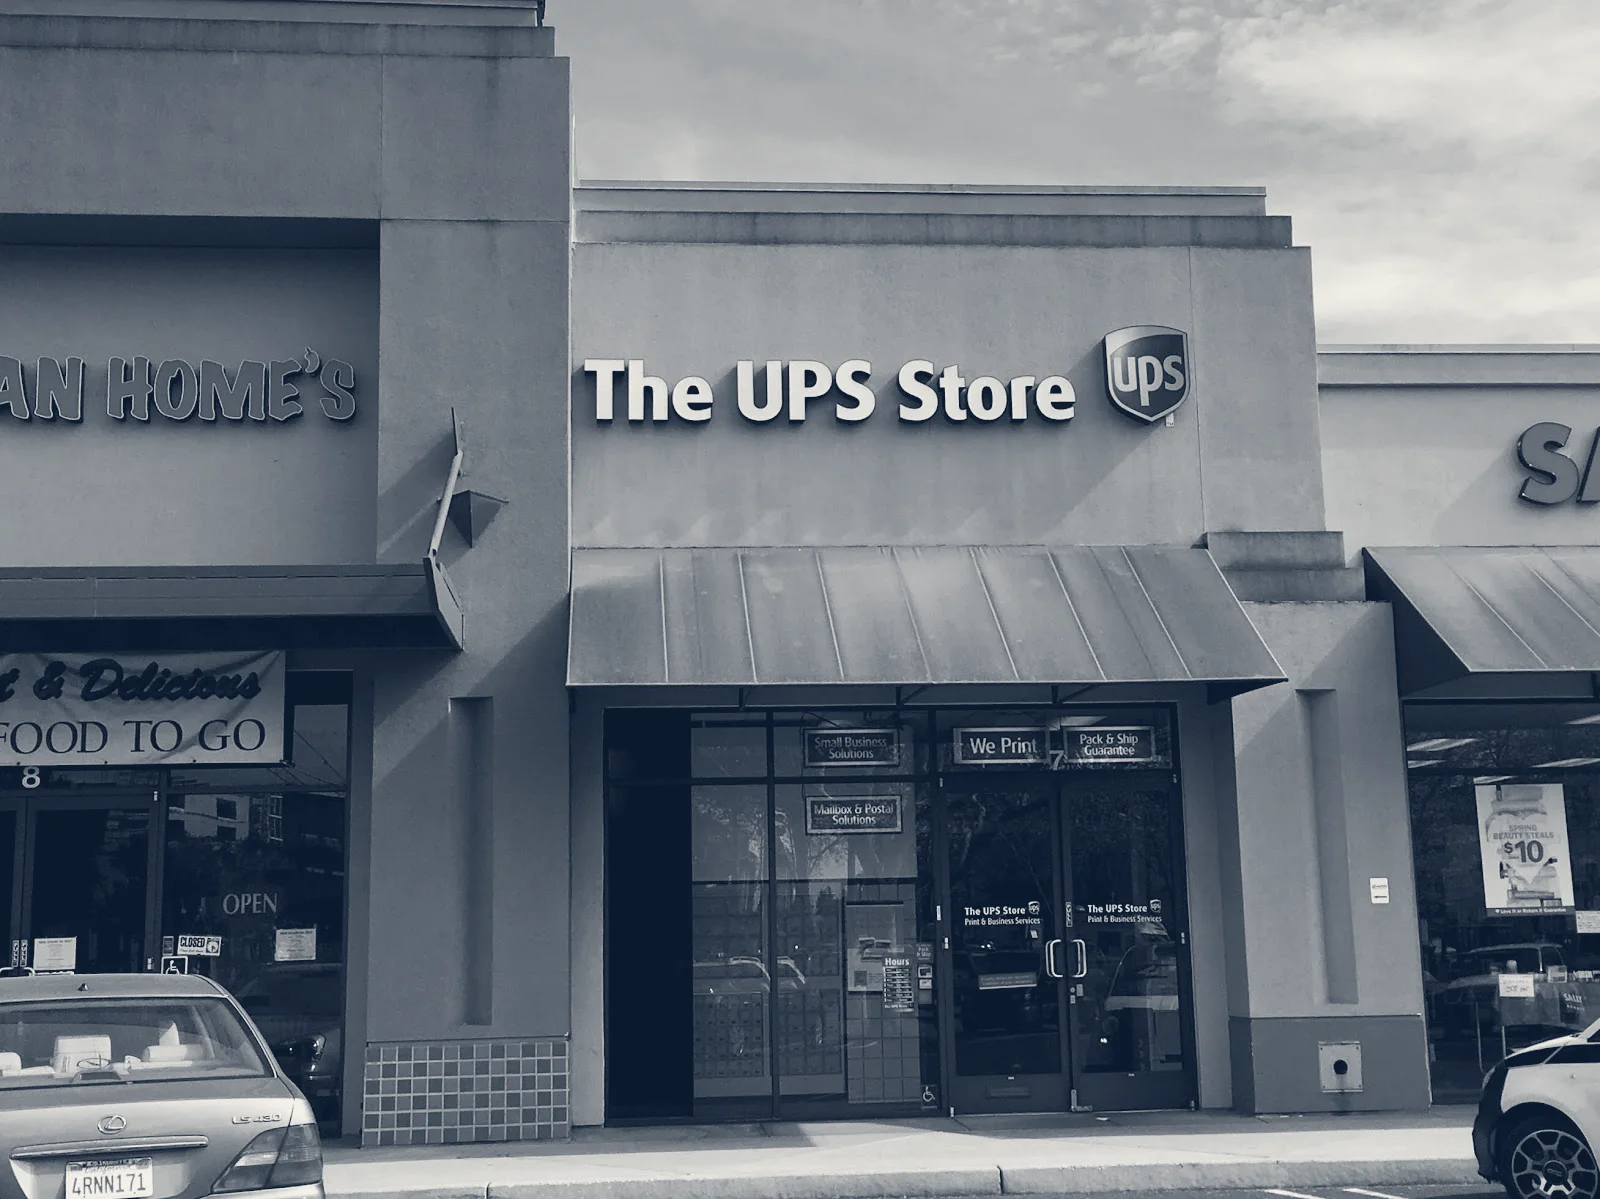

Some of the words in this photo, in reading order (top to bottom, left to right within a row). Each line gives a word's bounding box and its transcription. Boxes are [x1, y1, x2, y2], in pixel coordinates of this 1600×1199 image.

[0, 355, 86, 421] AN
[106, 346, 357, 421] HOME'S
[1113, 354, 1185, 406] ups
[584, 359, 714, 421] The
[737, 359, 876, 422] UPS
[898, 358, 1076, 421] Store
[1516, 422, 1600, 505] S
[33, 660, 67, 701] &
[79, 658, 262, 702] Delicious
[123, 720, 183, 753] TO
[198, 718, 266, 751] GO
[1080, 734, 1103, 745] Pack
[1106, 734, 1114, 744] &
[1117, 734, 1138, 746] Ship
[814, 737, 842, 748] Small
[845, 736, 887, 748] Business
[970, 738, 995, 754] We
[1001, 737, 1037, 753] Print
[829, 748, 874, 759] Solutions
[1084, 745, 1136, 756] Guarantee
[1049, 750, 1064, 770] 7
[21, 766, 41, 789] 8
[814, 804, 852, 815] Mailbox
[854, 803, 862, 814] &
[865, 803, 894, 814] Postal
[832, 814, 877, 826] Solutions
[1504, 840, 1544, 863] $10
[223, 893, 277, 915] OPEN
[1088, 905, 1103, 913] The
[1106, 904, 1123, 913] UPS
[1125, 904, 1147, 912] Store
[964, 907, 981, 916] The
[983, 906, 1001, 915] UPS
[1003, 906, 1025, 914] Store
[964, 918, 979, 926] Print
[981, 917, 986, 925] &
[988, 917, 1014, 925] Business
[1015, 916, 1041, 925] Services
[1088, 915, 1102, 923] Print
[1104, 915, 1108, 923] &
[1110, 915, 1136, 923] Business
[1137, 914, 1162, 923] Services
[180, 936, 205, 948] CLOSED
[885, 957, 910, 966] Hours
[231, 1115, 252, 1124] LS
[253, 1113, 282, 1123] 430
[72, 1172, 146, 1196] 4RNN171
